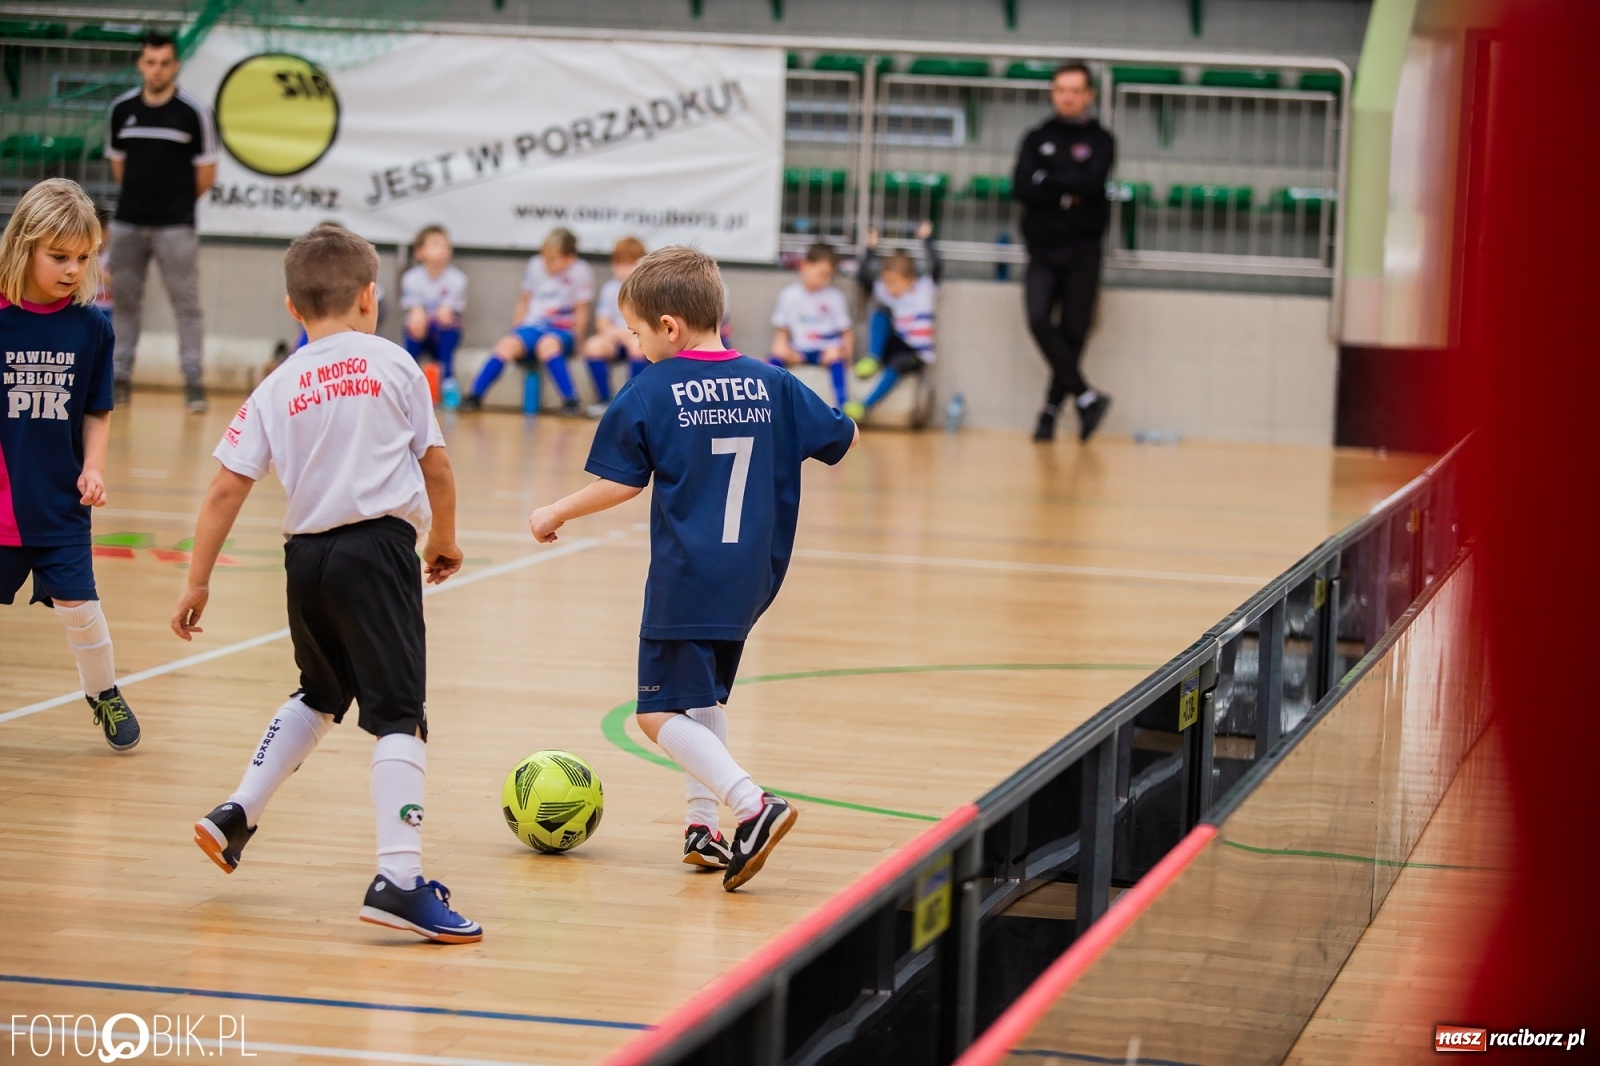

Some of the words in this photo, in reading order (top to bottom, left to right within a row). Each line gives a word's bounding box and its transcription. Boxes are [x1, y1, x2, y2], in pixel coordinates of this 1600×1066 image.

[365, 152, 457, 205] JEST
[467, 138, 505, 175] W
[514, 80, 750, 165] PORZĄDKU!
[5, 351, 75, 365] PAWILON
[3, 371, 75, 386] MEBLOWY
[299, 371, 312, 389] AP
[671, 377, 770, 406] FORTECA
[7, 391, 71, 420] PIK
[288, 389, 321, 417] LKS-U
[677, 407, 771, 427] ŚWIERKLANY
[711, 436, 755, 543] 7
